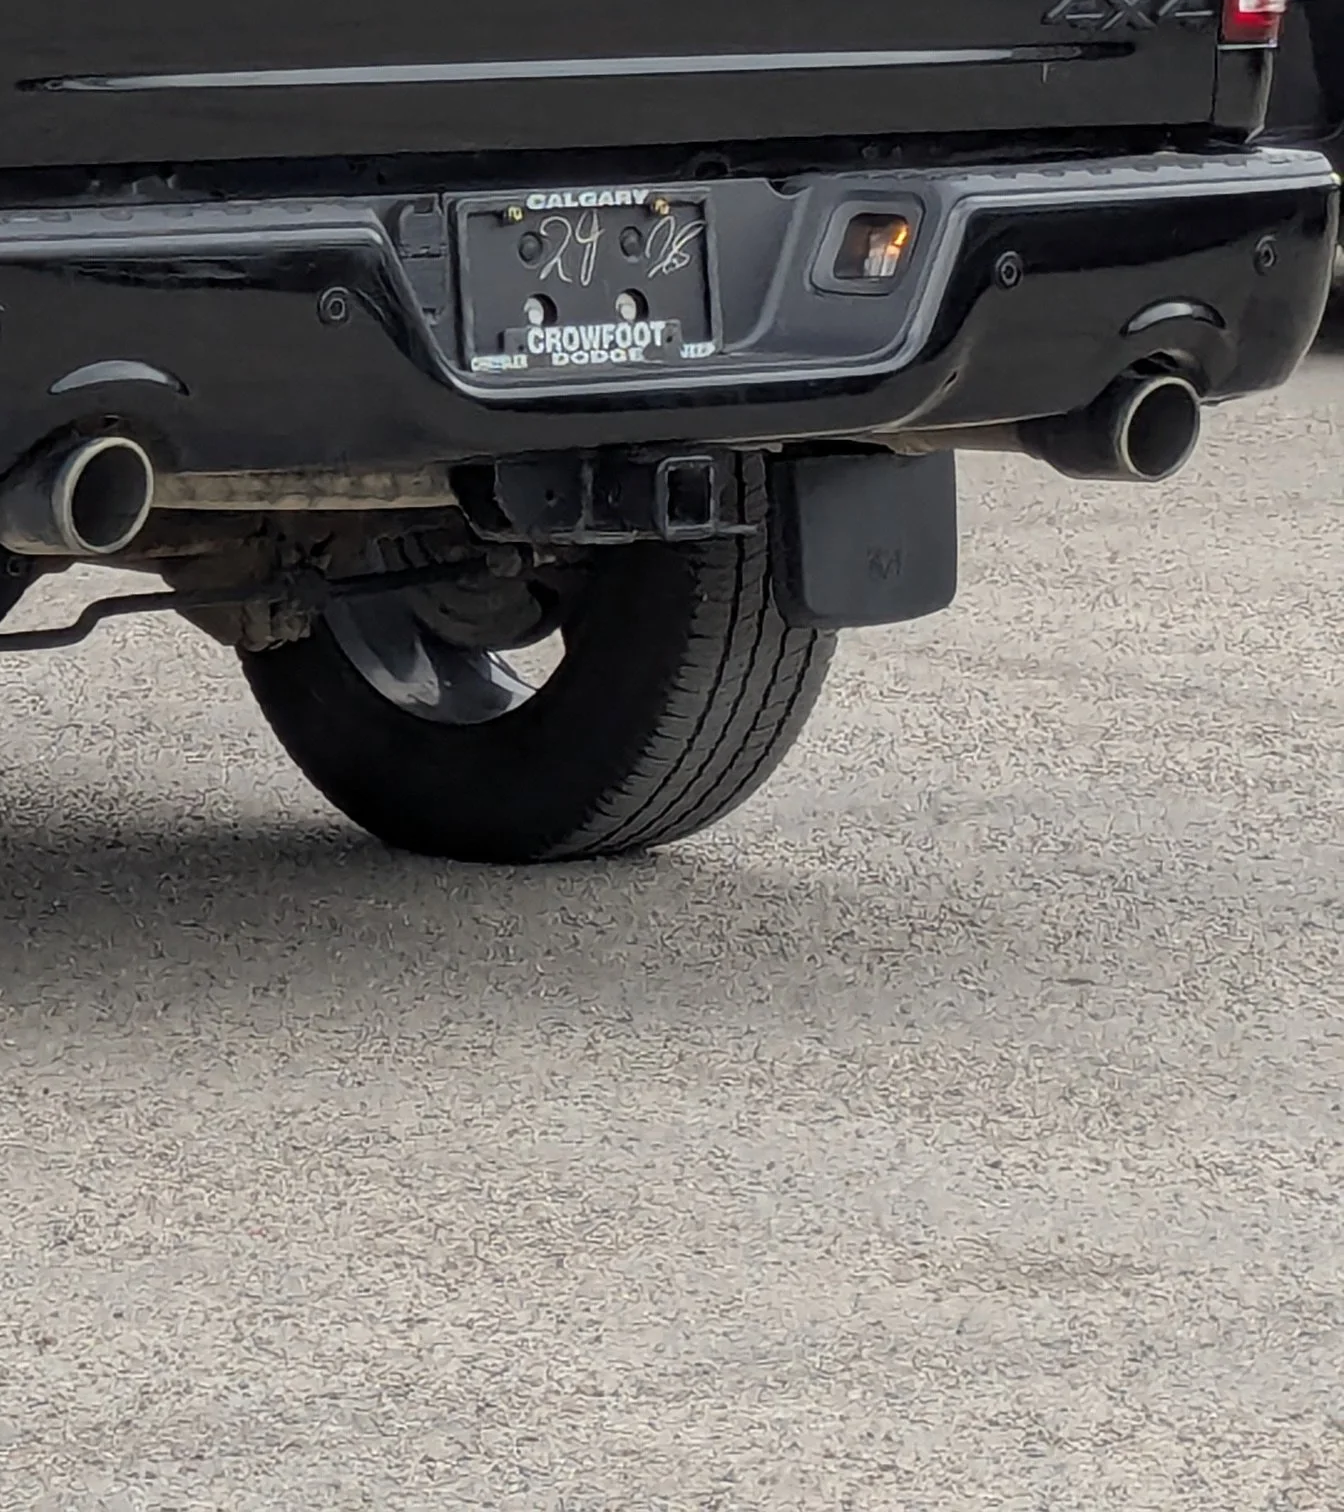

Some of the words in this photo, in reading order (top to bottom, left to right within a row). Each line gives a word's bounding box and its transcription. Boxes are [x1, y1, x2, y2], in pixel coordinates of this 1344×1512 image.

[526, 189, 650, 210] CALGARY
[527, 321, 666, 354] CROWFOOT
[551, 347, 645, 366] DODGE
